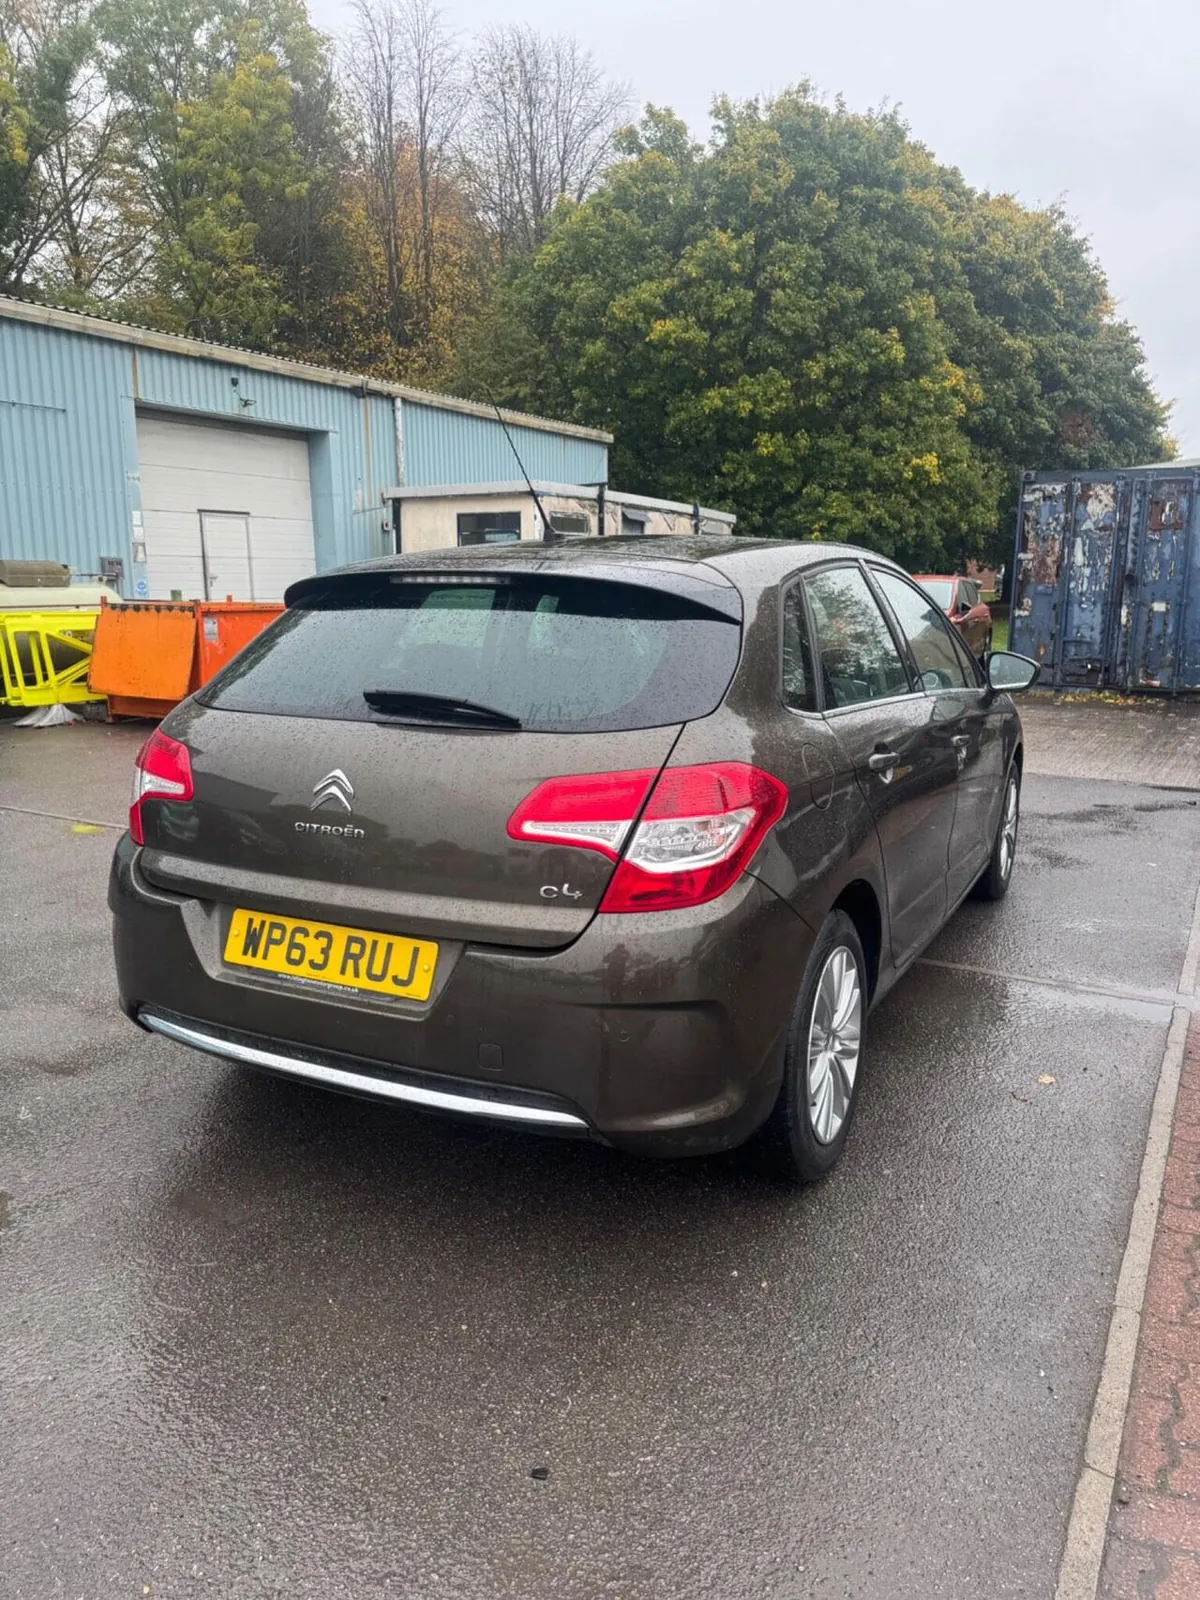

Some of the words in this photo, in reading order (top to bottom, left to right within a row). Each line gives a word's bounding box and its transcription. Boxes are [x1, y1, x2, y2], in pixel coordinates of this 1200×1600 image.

[540, 883, 583, 900] C4
[242, 917, 333, 971] WP63
[340, 935, 420, 987] RUJ
